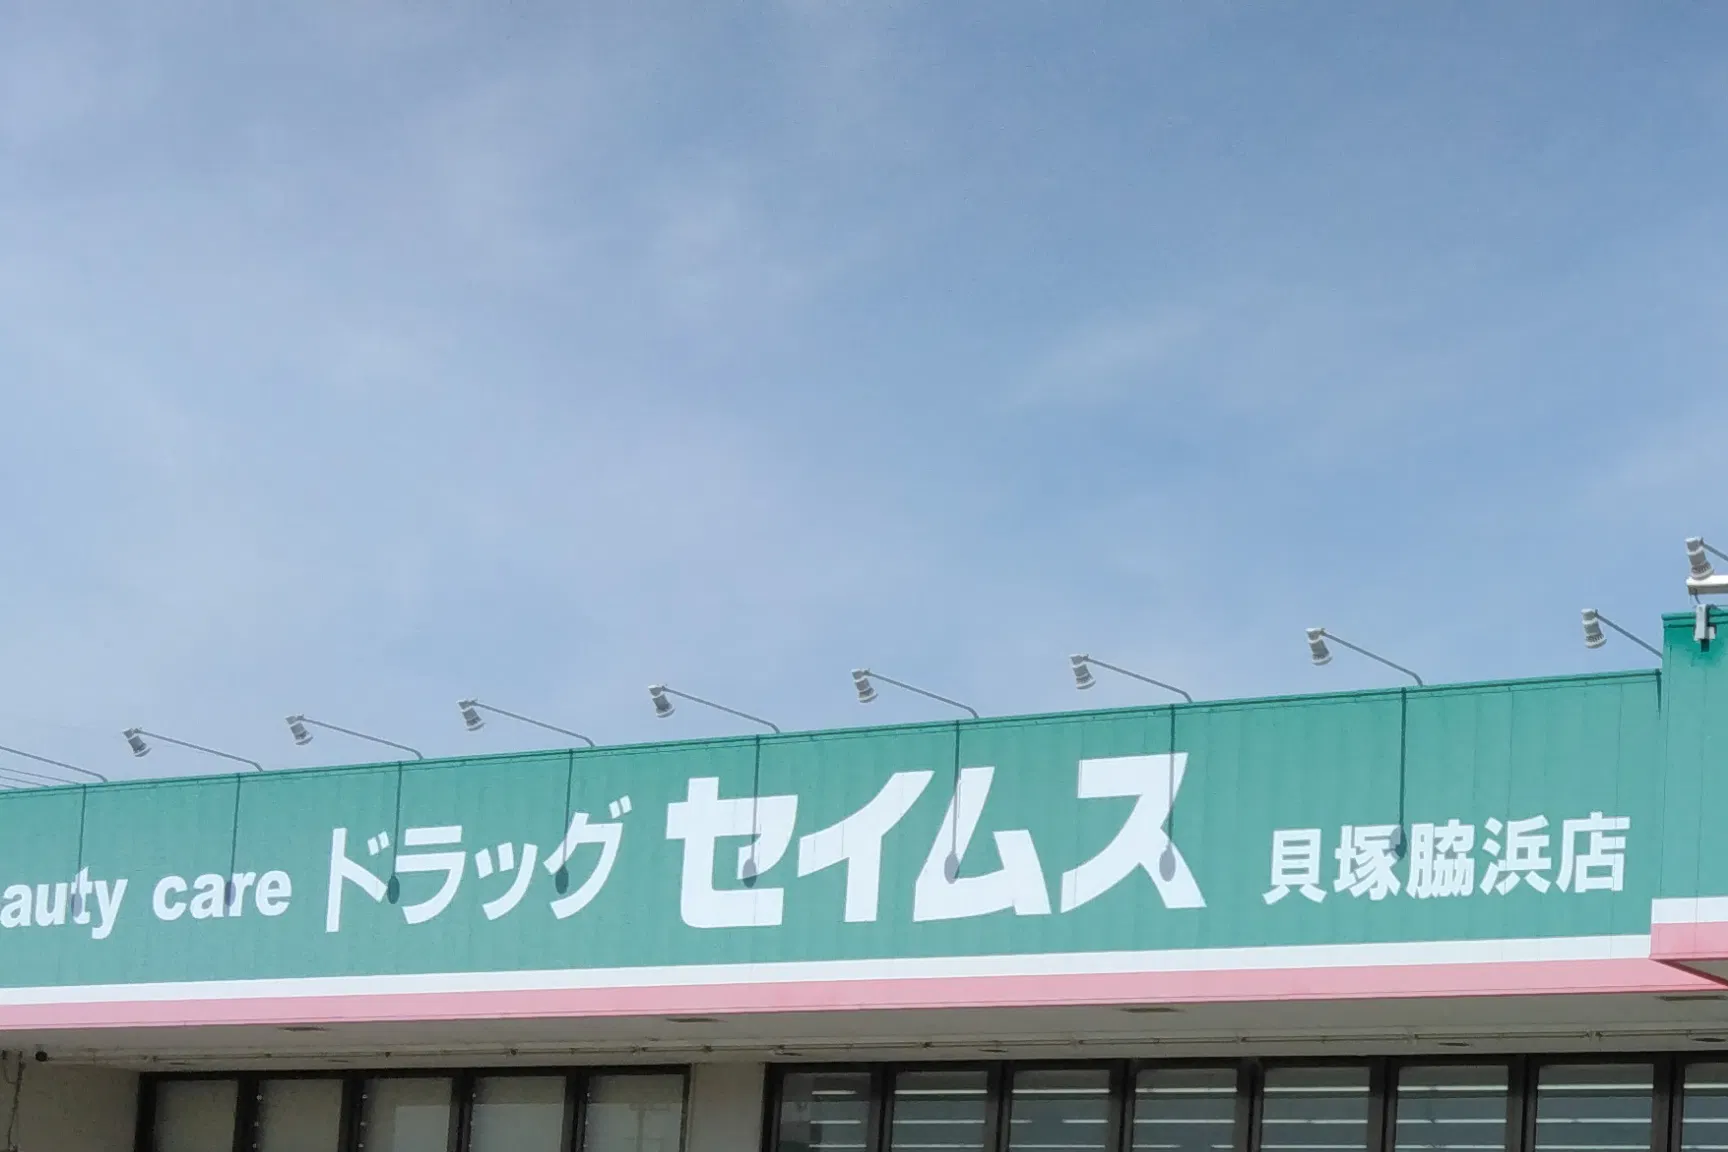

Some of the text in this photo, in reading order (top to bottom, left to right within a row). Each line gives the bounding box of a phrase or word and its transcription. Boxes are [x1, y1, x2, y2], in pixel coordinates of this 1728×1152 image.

[0, 751, 1631, 940] auty care ドラッグ セイムス 貝塚脇浜店
